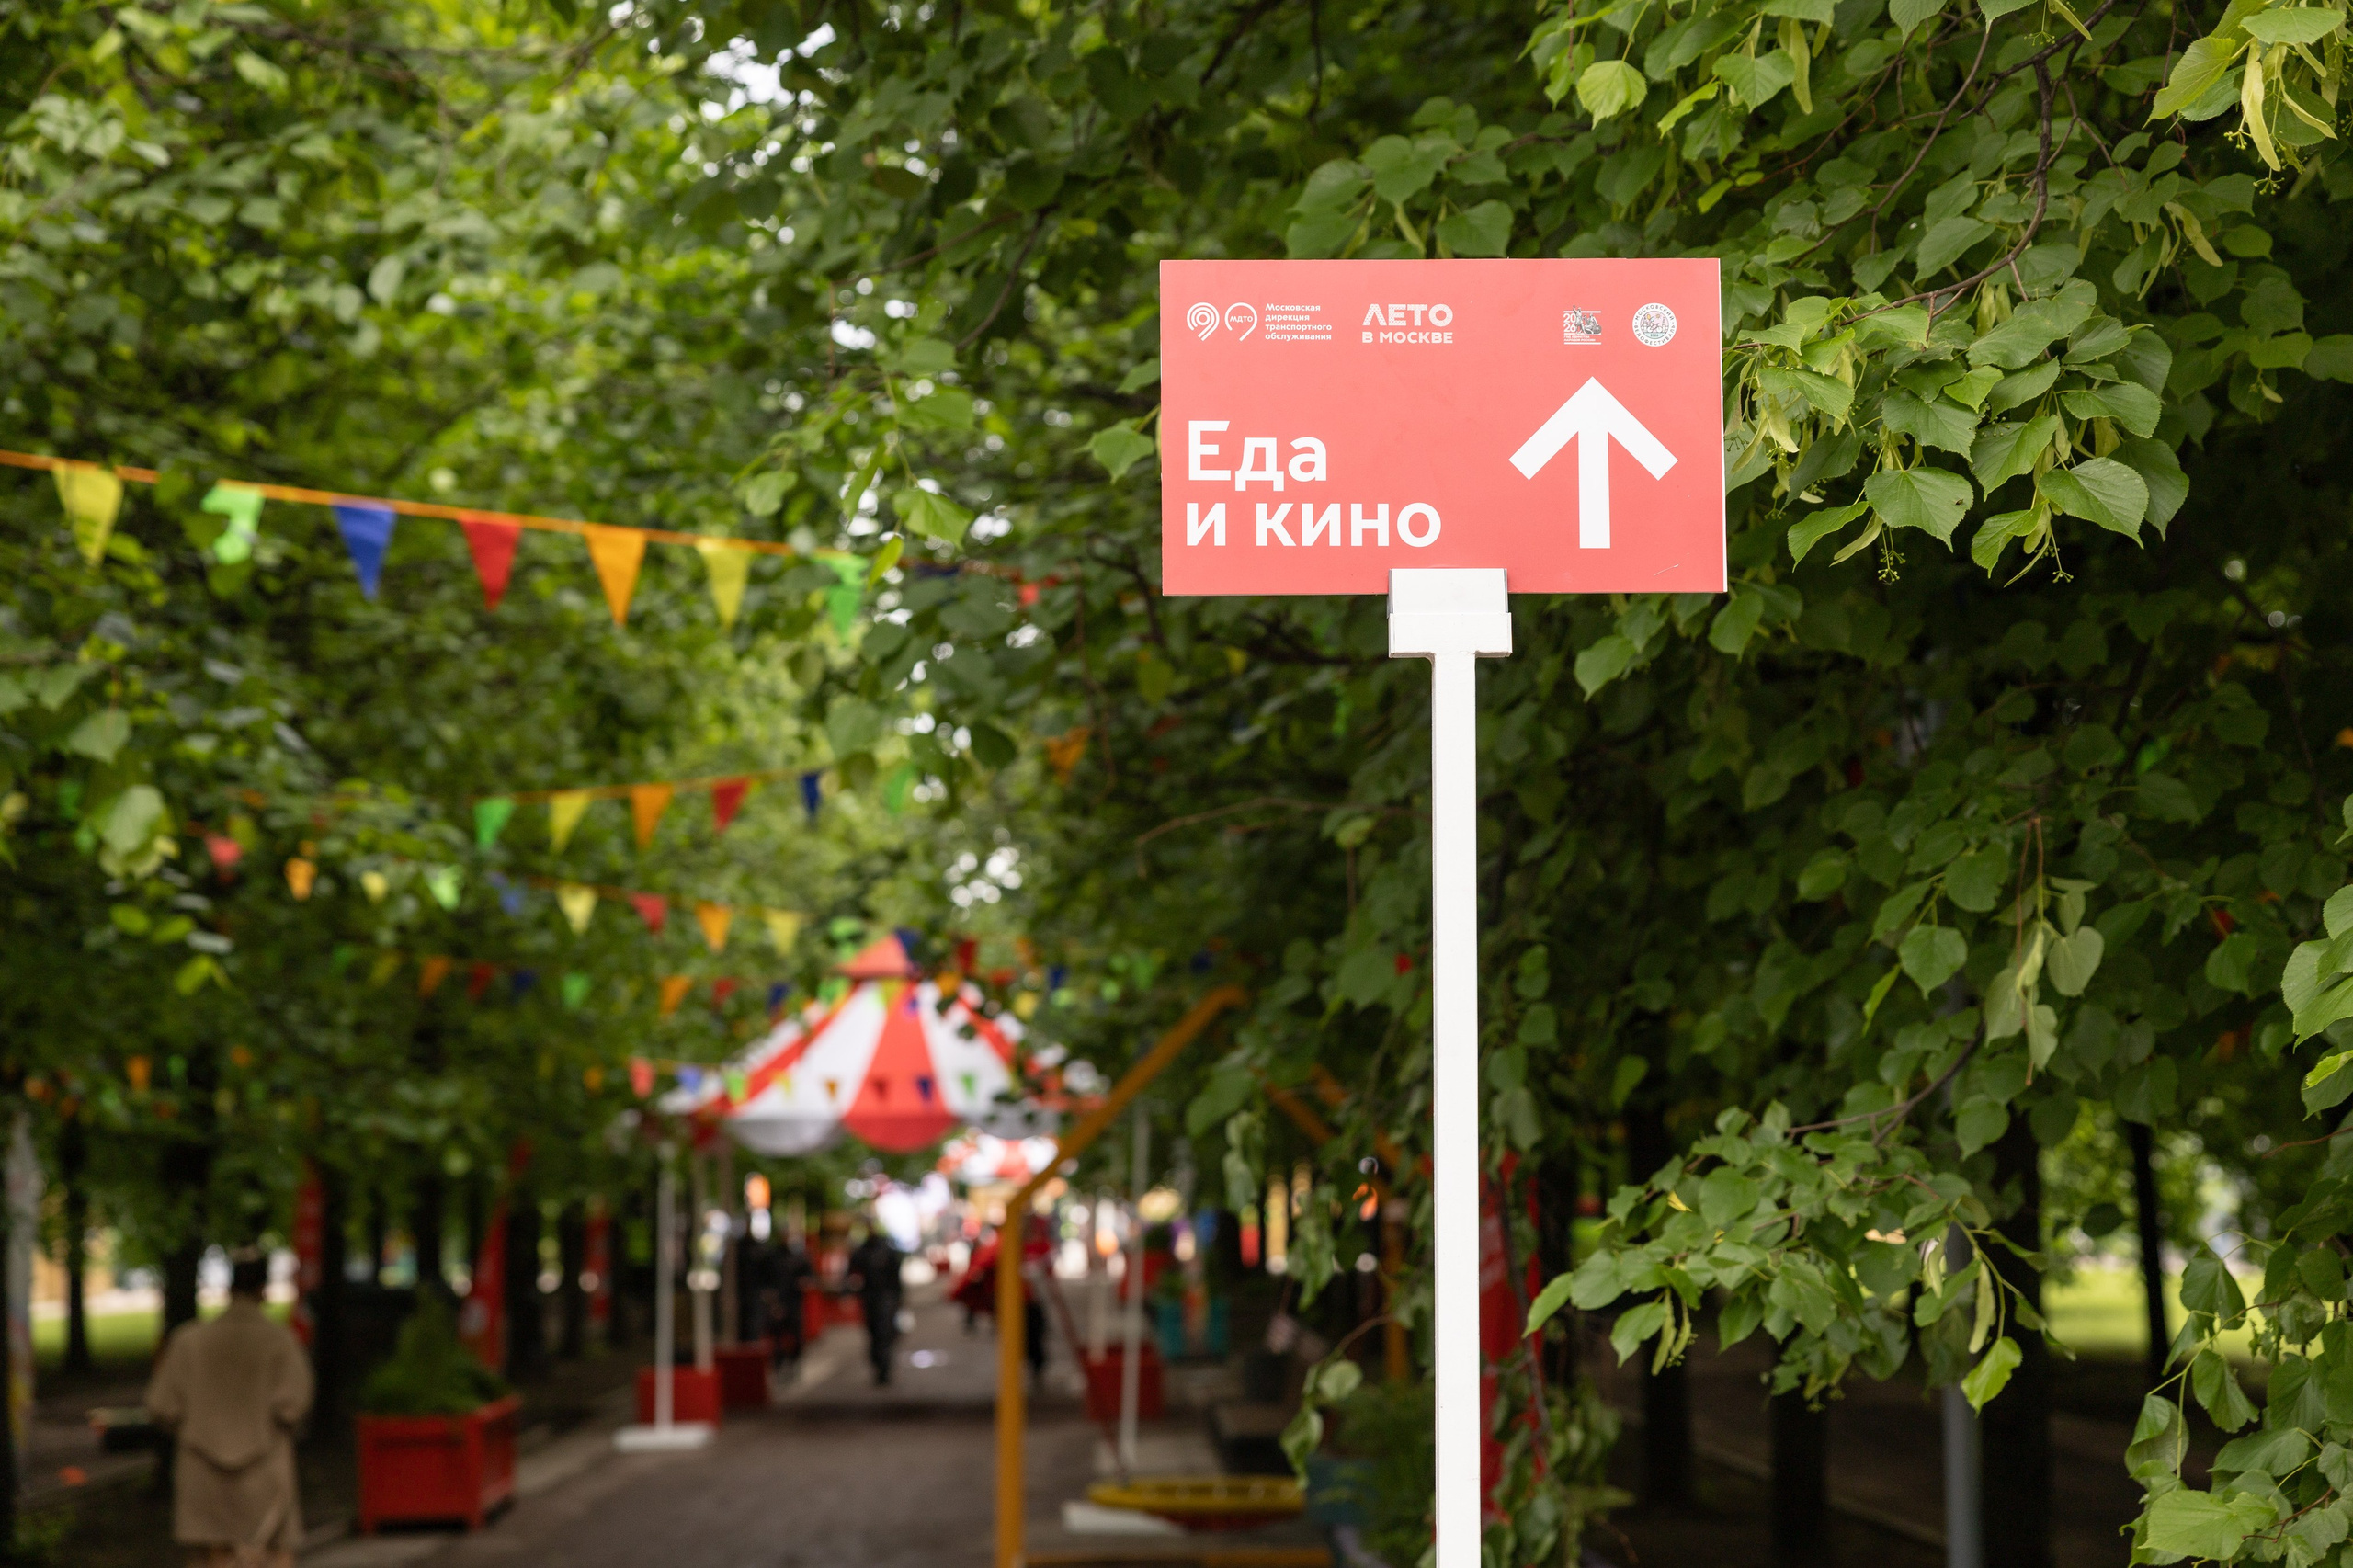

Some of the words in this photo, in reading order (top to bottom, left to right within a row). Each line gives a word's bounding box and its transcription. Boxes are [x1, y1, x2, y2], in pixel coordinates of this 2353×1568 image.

[1265, 303, 1321, 312] Московская
[1362, 303, 1454, 326] ЛЕТО
[1265, 324, 1332, 332] транспортного
[1265, 332, 1332, 341] обслуживания
[1362, 331, 1373, 344] В
[1379, 331, 1454, 344] МОСКВЕ
[1188, 420, 1327, 492] Еда
[1187, 503, 1226, 546] и
[1256, 502, 1441, 548] кино
